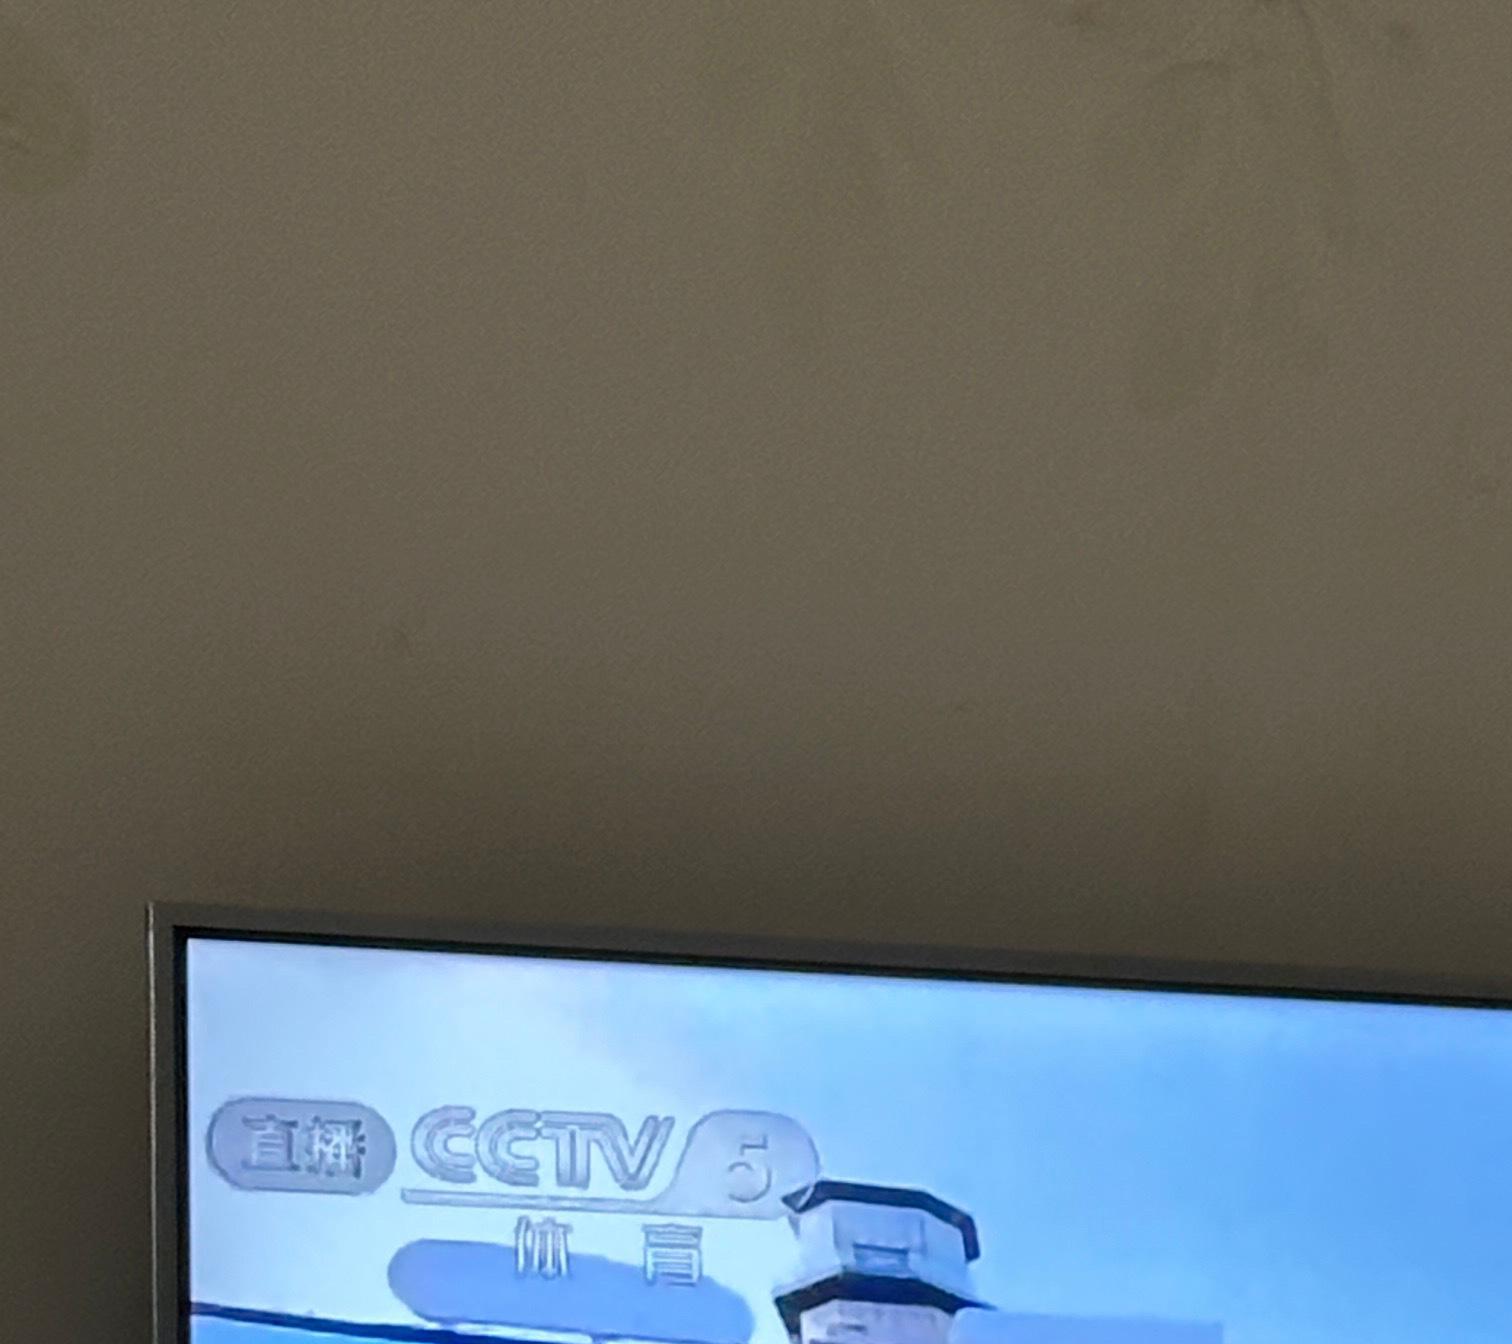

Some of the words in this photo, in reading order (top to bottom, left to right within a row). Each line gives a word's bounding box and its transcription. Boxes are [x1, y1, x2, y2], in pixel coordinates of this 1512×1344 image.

[241, 1113, 367, 1180] 直播
[411, 1105, 675, 1191] CCTV
[512, 1215, 704, 1287] 体育
